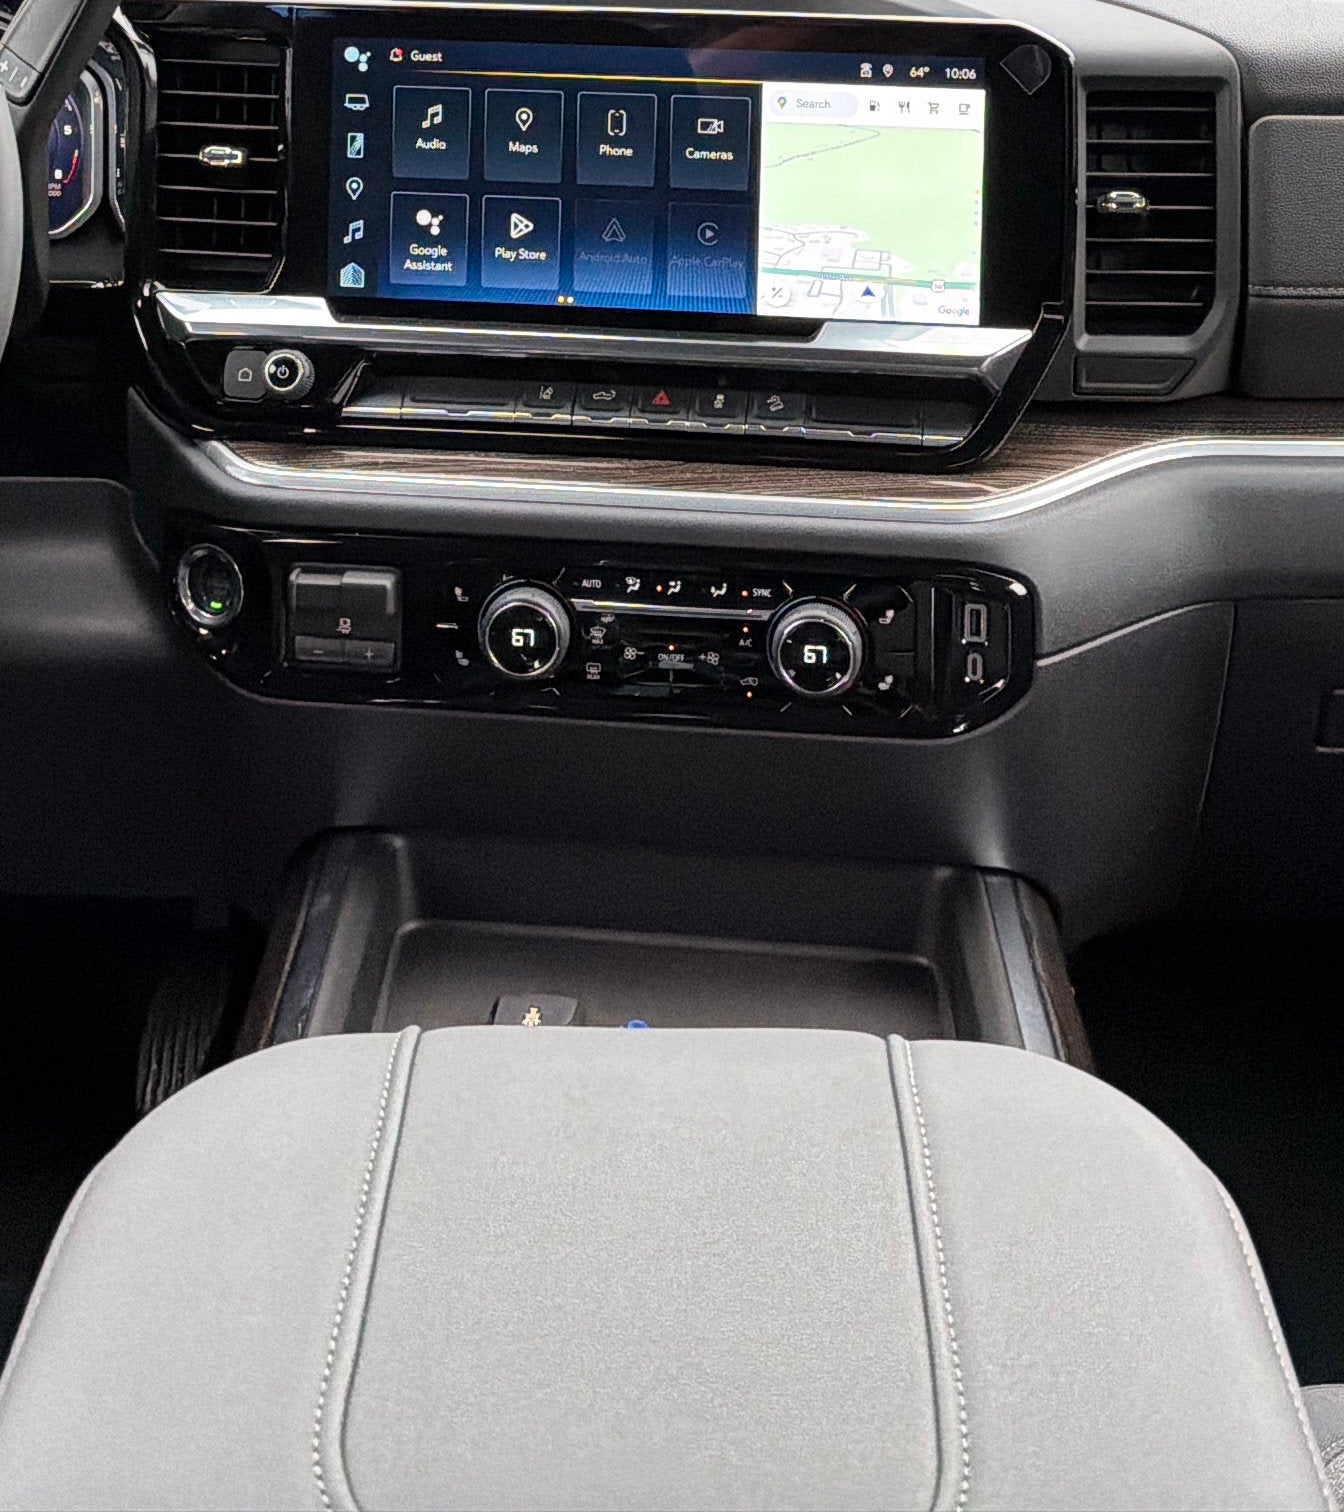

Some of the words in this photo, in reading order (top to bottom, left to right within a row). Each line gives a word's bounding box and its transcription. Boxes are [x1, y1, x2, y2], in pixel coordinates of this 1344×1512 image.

[410, 50, 443, 62] Guest
[944, 67, 977, 80] 10:06
[795, 98, 831, 109] Search
[63, 124, 72, 135] 5
[415, 138, 447, 150] Audio
[508, 141, 539, 155] Maps
[599, 144, 633, 157] Phone
[685, 147, 734, 160] Cameras
[409, 244, 448, 258] Google
[495, 247, 519, 262] Play
[519, 248, 547, 260] Store
[579, 251, 619, 262] Android
[621, 254, 647, 264] Auto
[403, 259, 453, 272] Assistant
[703, 256, 744, 270] CarPlay
[937, 305, 970, 317] Google
[581, 578, 602, 588] AUTO
[752, 588, 772, 598] SYNC
[511, 628, 535, 647] 67
[738, 638, 752, 648] A/C
[658, 653, 685, 662] ON/OFF
[803, 645, 828, 664] 67
